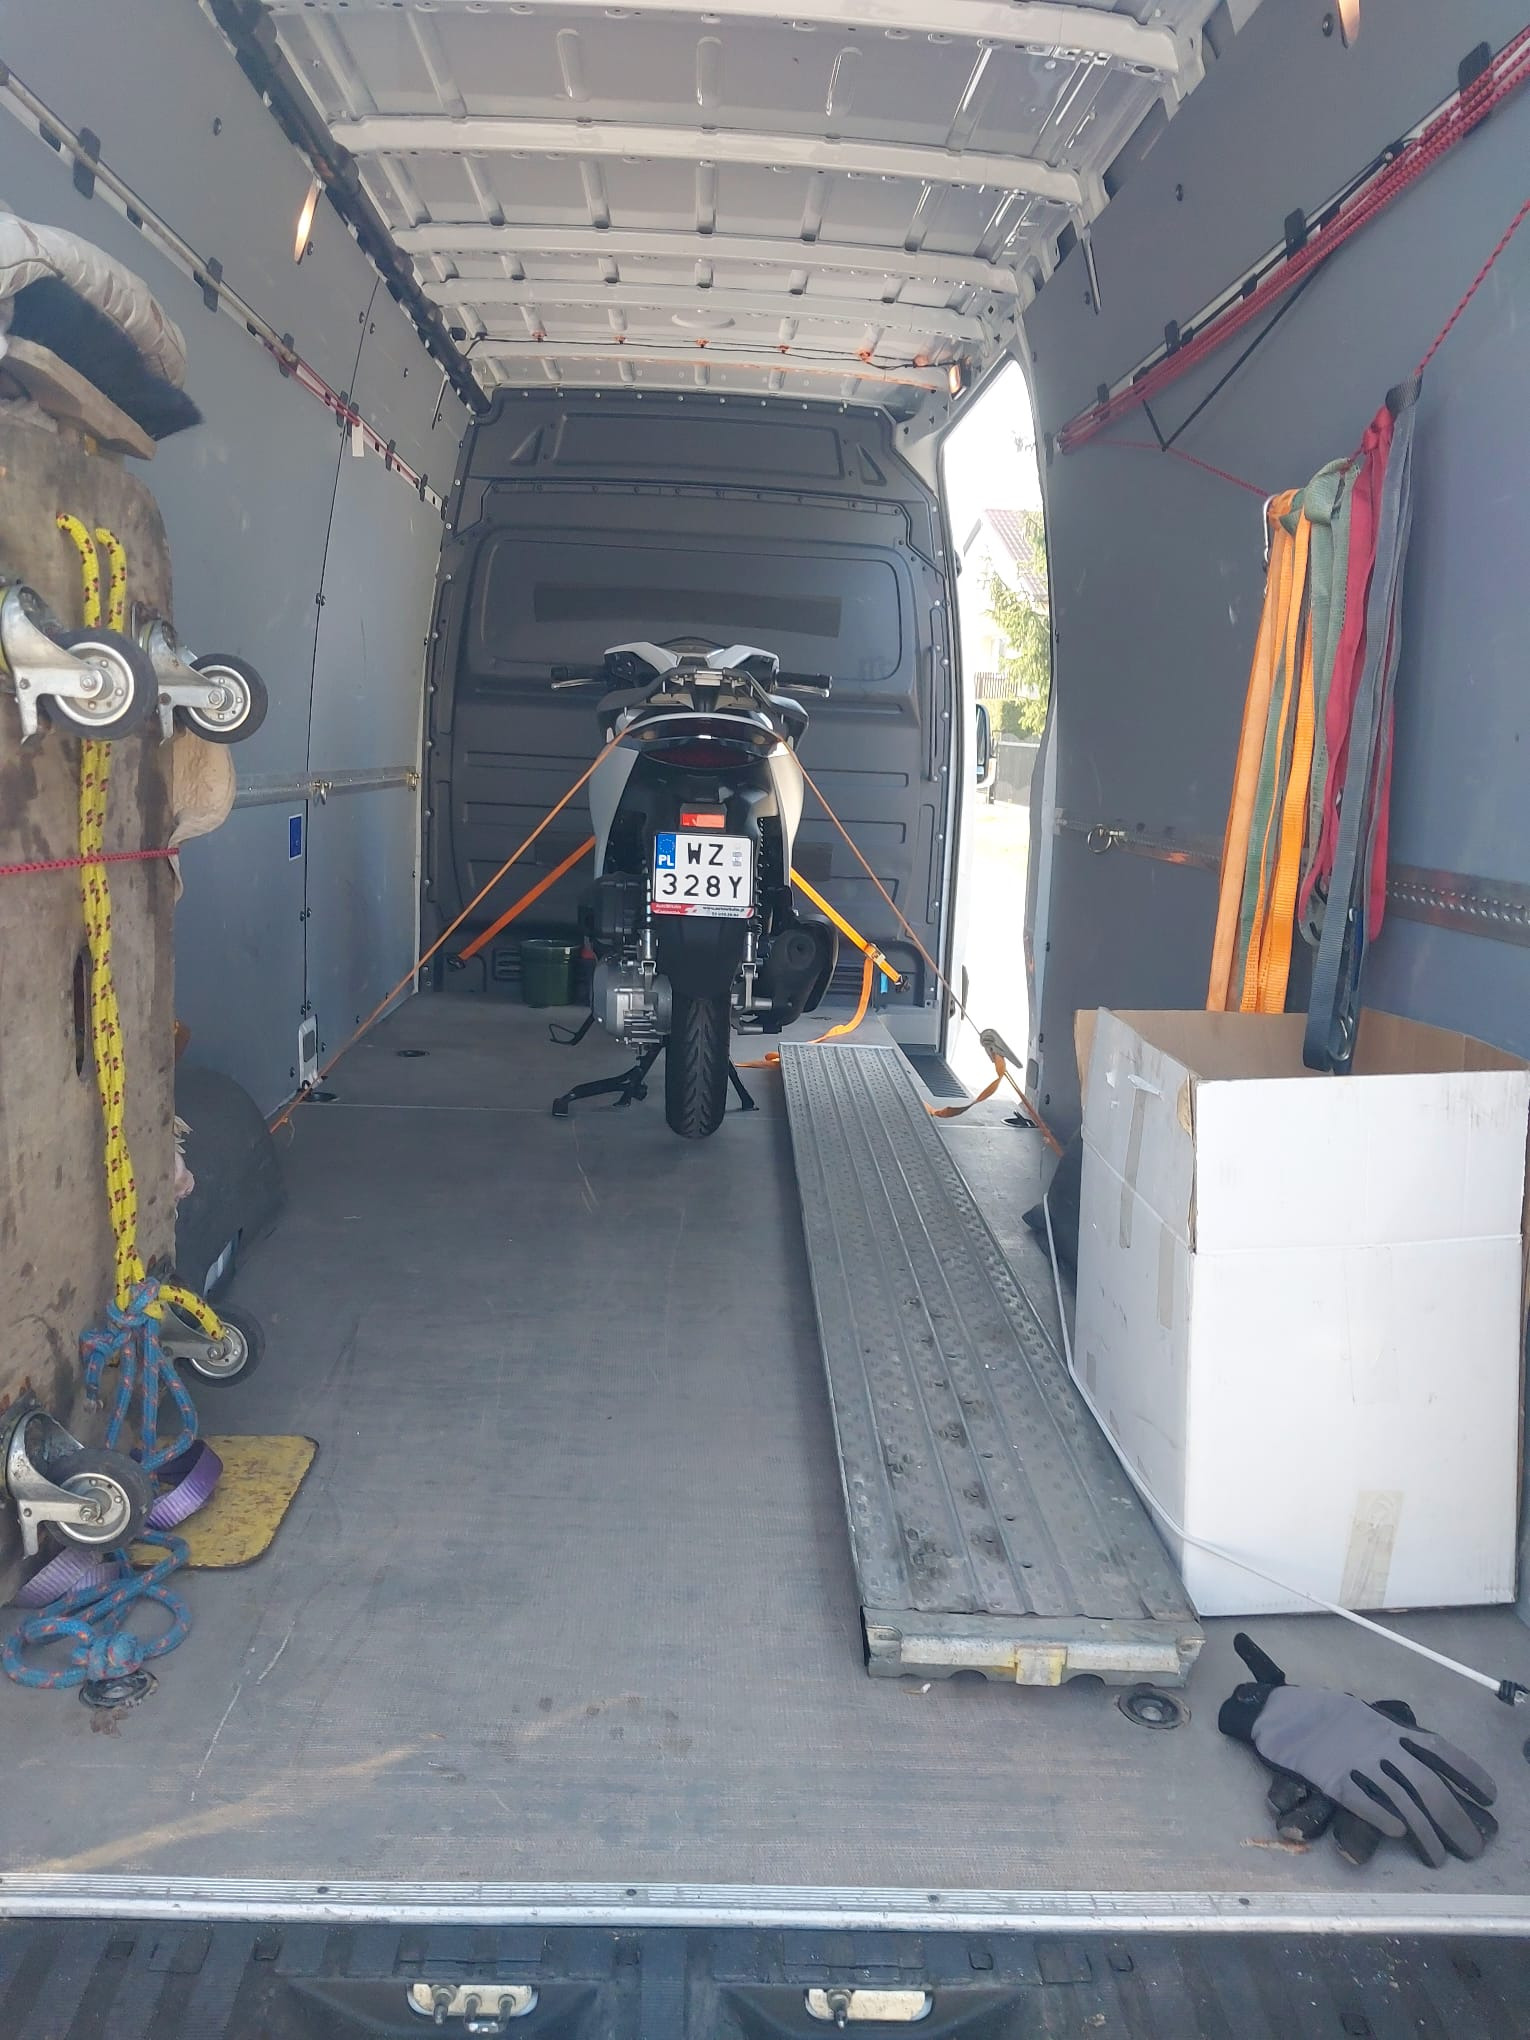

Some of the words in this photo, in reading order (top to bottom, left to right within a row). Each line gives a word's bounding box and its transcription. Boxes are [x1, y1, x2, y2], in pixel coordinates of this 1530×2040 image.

[658, 854, 675, 867] PL
[687, 842, 724, 866] WZ
[662, 873, 742, 899] 328Y
